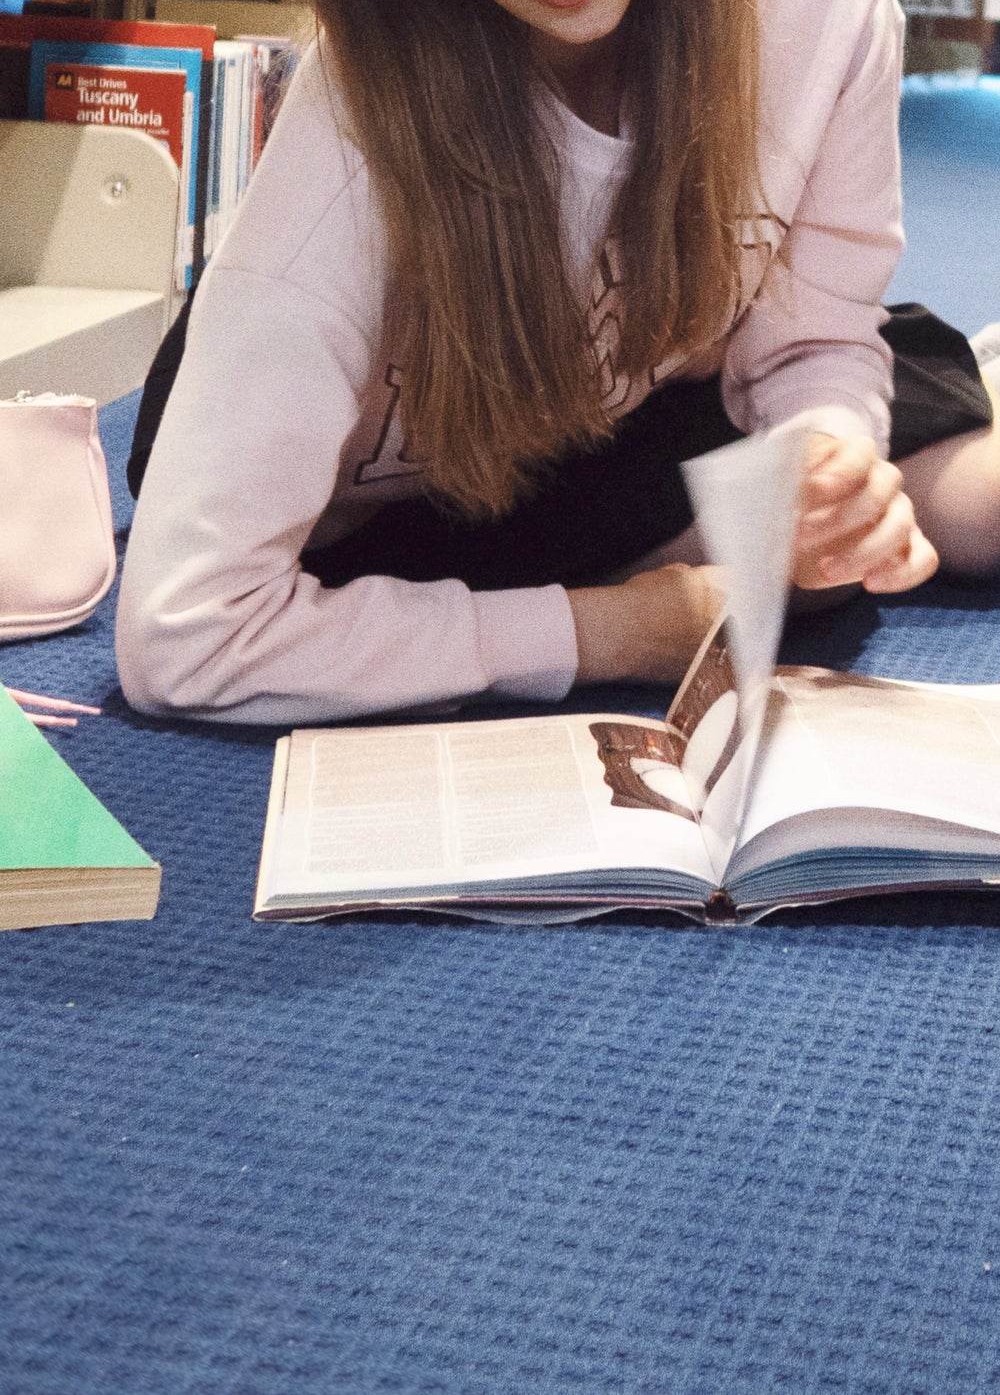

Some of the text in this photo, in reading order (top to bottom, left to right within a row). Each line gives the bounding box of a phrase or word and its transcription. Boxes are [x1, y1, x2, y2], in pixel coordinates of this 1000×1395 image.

[78, 77, 127, 89] Best Drives
[78, 87, 138, 109] Tuscany
[77, 107, 162, 126] and Umbria
